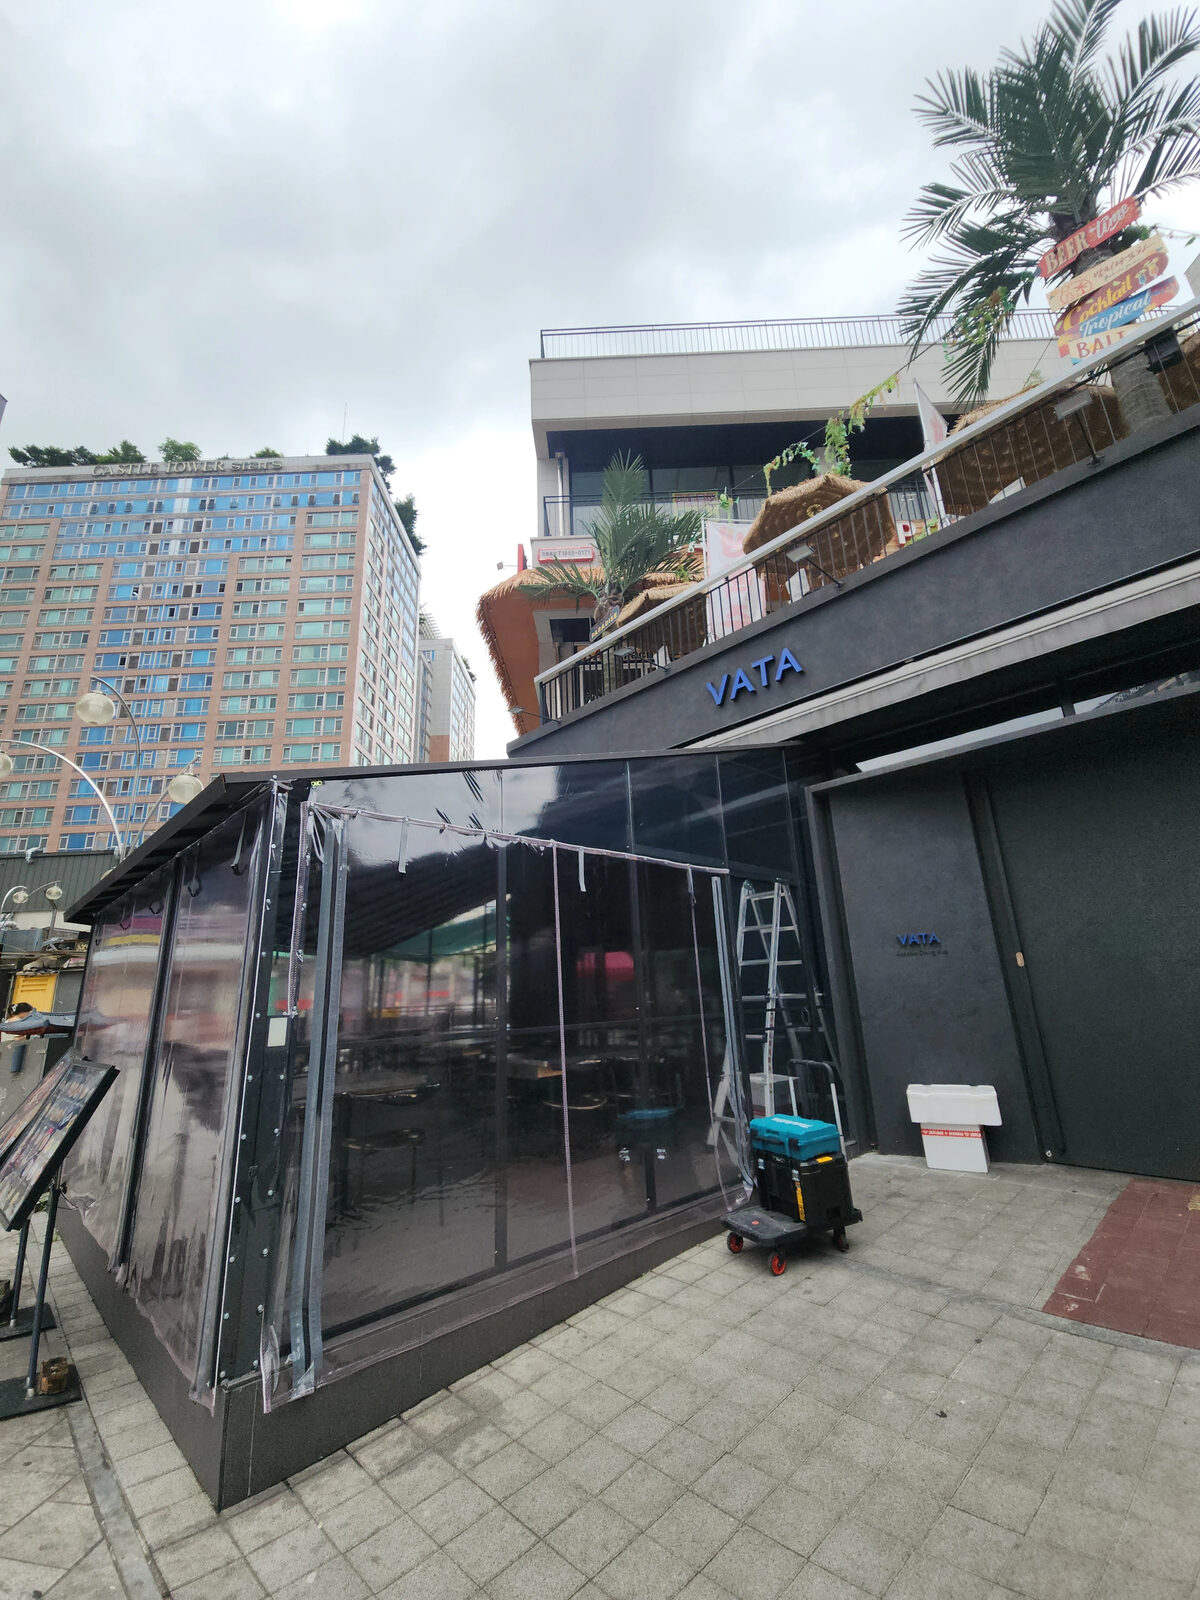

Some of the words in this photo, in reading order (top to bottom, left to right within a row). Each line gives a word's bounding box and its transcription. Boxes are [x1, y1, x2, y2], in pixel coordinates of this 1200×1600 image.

[1044, 231, 1090, 274] BEER
[1063, 274, 1133, 331] Cocktail
[1080, 288, 1152, 338] Tropical
[91, 463, 158, 477] CASTLE
[165, 460, 225, 474] TOWER
[705, 647, 804, 706] VATA
[896, 931, 941, 945] VATA
